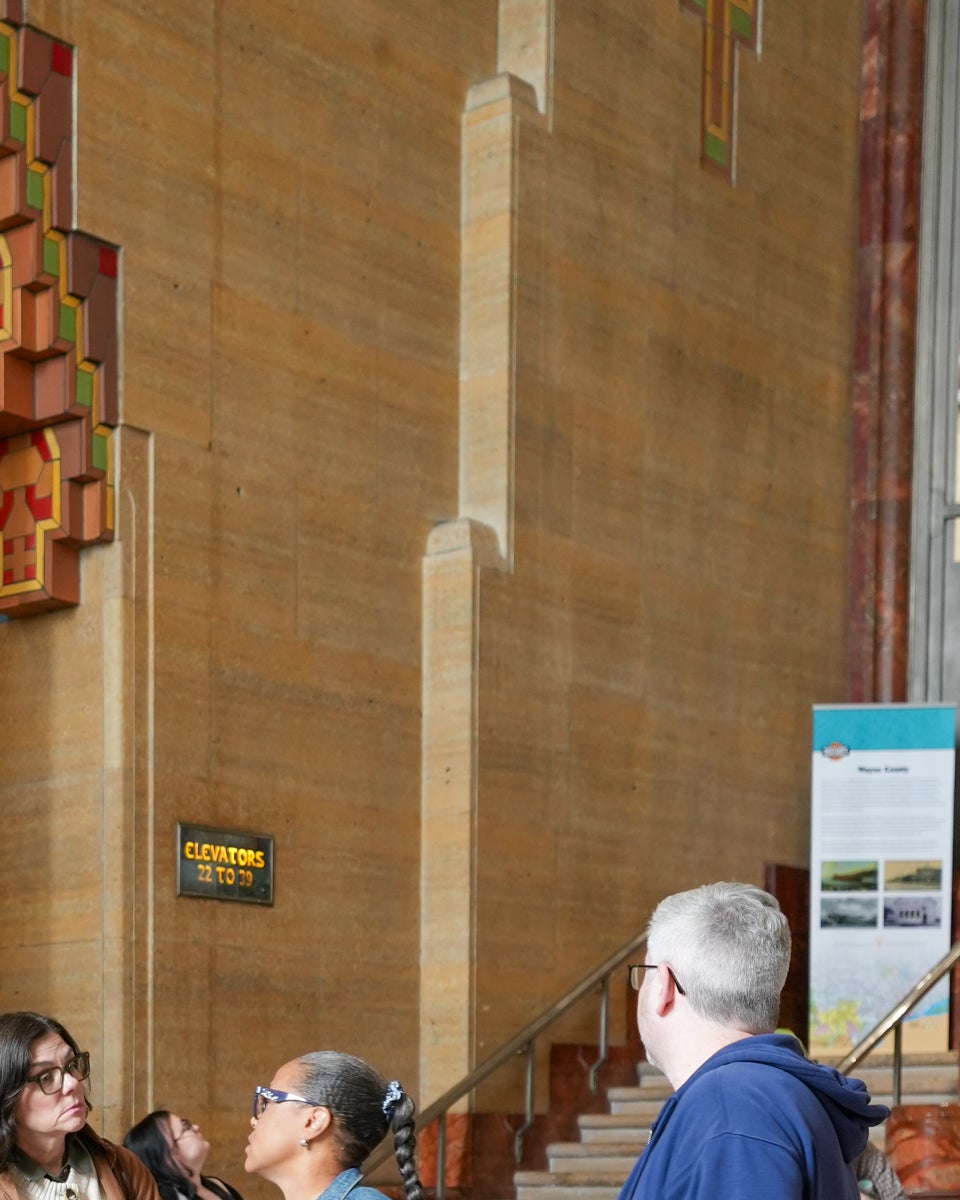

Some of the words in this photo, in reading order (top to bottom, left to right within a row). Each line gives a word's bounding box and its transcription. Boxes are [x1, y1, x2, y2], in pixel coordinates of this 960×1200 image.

[184, 841, 265, 868] ELEVATORS
[197, 864, 212, 882] 22
[216, 866, 235, 885] TO
